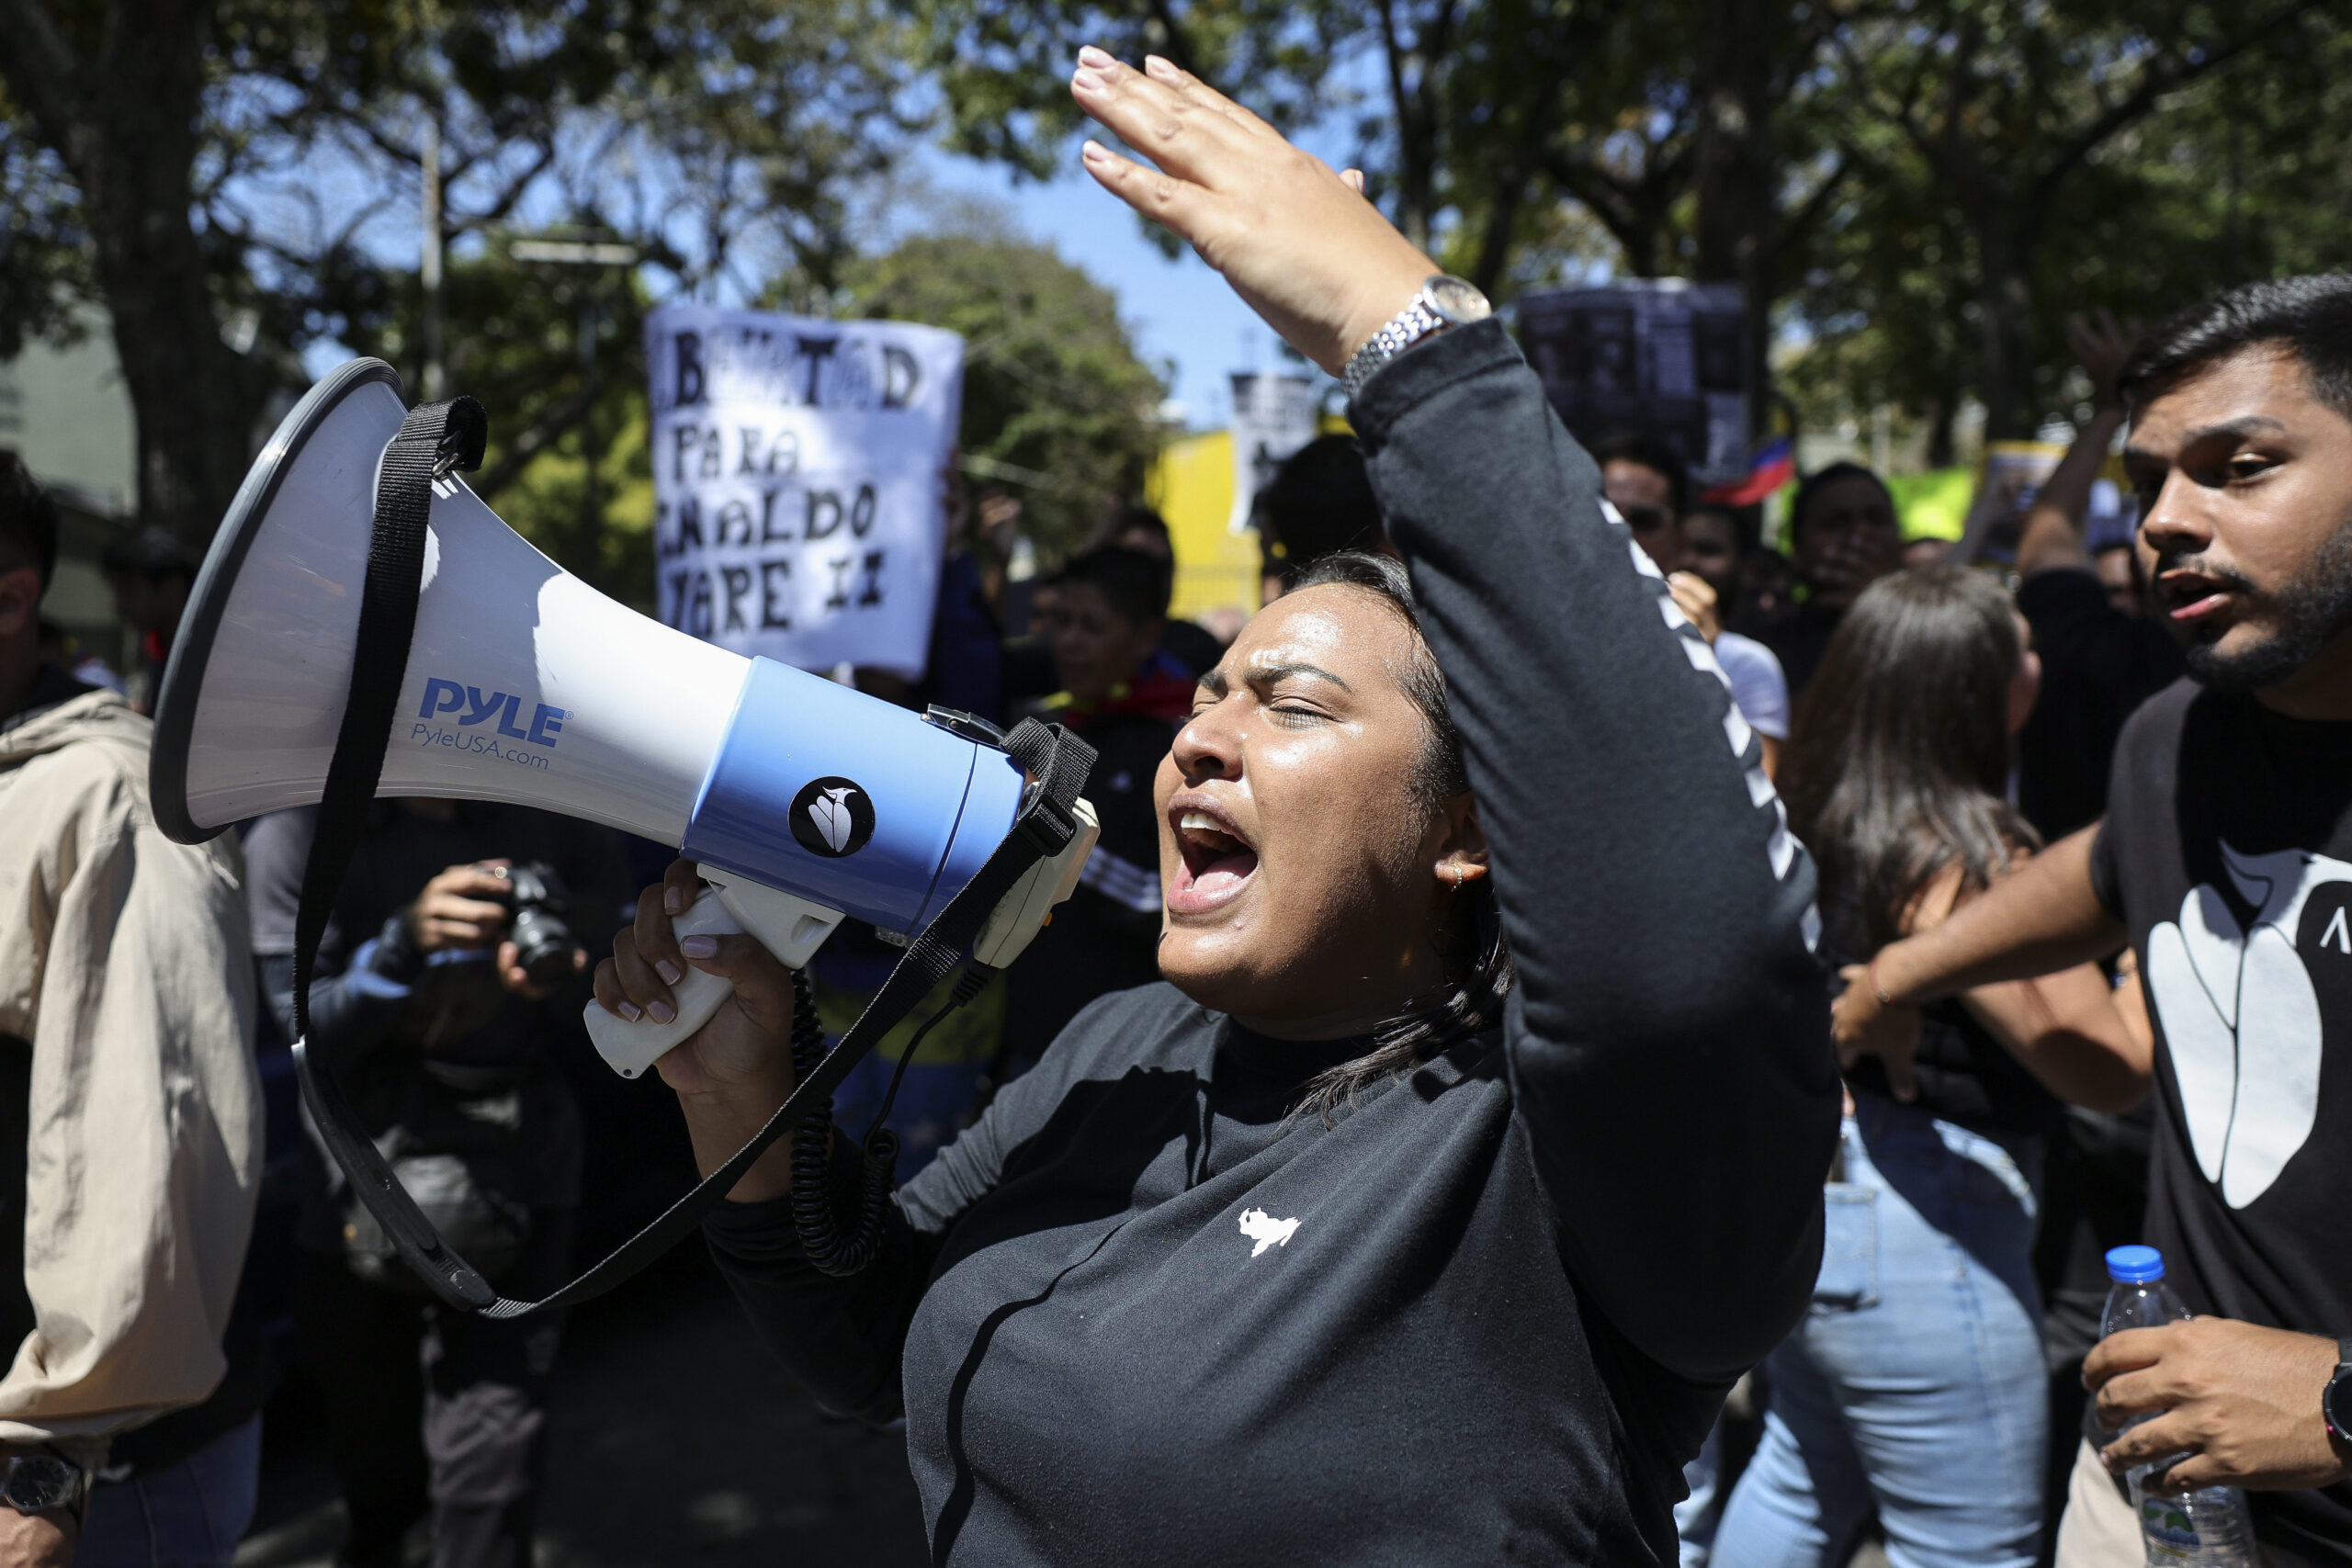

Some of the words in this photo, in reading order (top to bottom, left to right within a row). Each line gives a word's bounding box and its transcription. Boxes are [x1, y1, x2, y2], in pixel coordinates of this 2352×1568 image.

[673, 425, 800, 480] PARA
[418, 677, 565, 748] PYLE
[411, 723, 549, 770] PyleUSA.com
